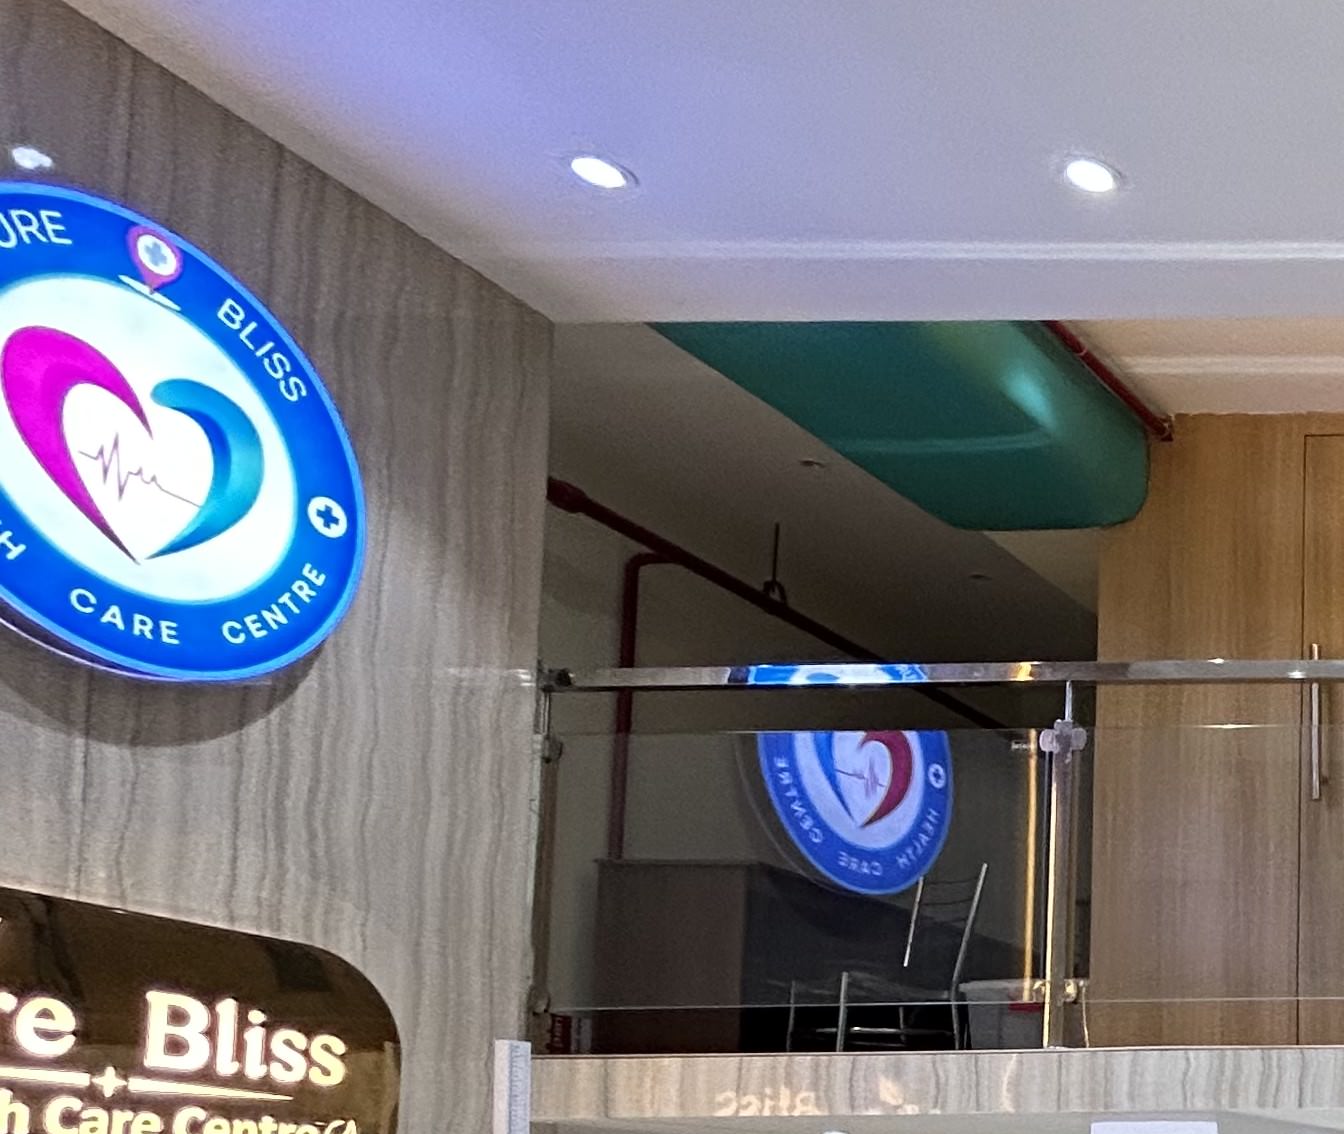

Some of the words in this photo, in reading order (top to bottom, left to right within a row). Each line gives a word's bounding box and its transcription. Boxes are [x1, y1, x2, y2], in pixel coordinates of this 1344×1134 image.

[216, 298, 307, 402] BLISS
[69, 588, 180, 645] CARE
[222, 562, 326, 645] CENTRE
[143, 990, 348, 1087] Bliss
